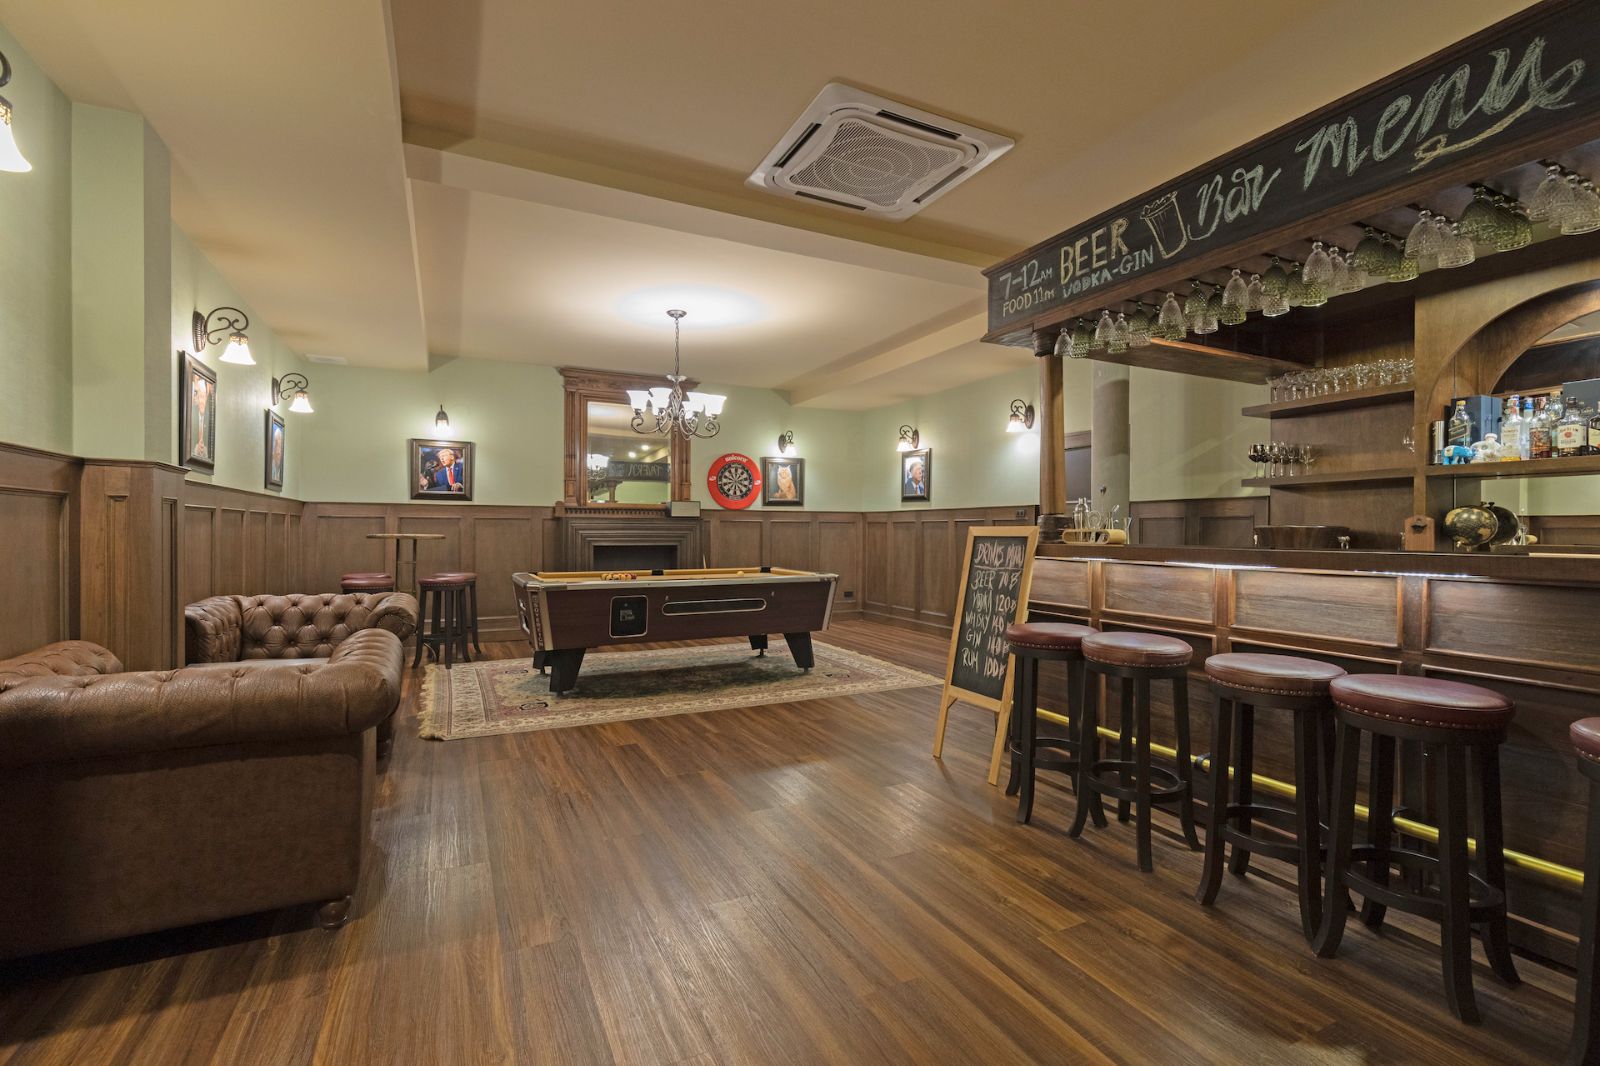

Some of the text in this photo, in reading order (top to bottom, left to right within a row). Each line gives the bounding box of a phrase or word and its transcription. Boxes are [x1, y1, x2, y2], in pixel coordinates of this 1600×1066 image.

[1187, 164, 1282, 239] Bar
[1060, 217, 1130, 285] BEER
[1003, 292, 1032, 317] FOOD
[724, 455, 750, 464] unicorn
[970, 570, 996, 590] BEER
[965, 628, 982, 648] GIN
[961, 647, 980, 674] RUM
